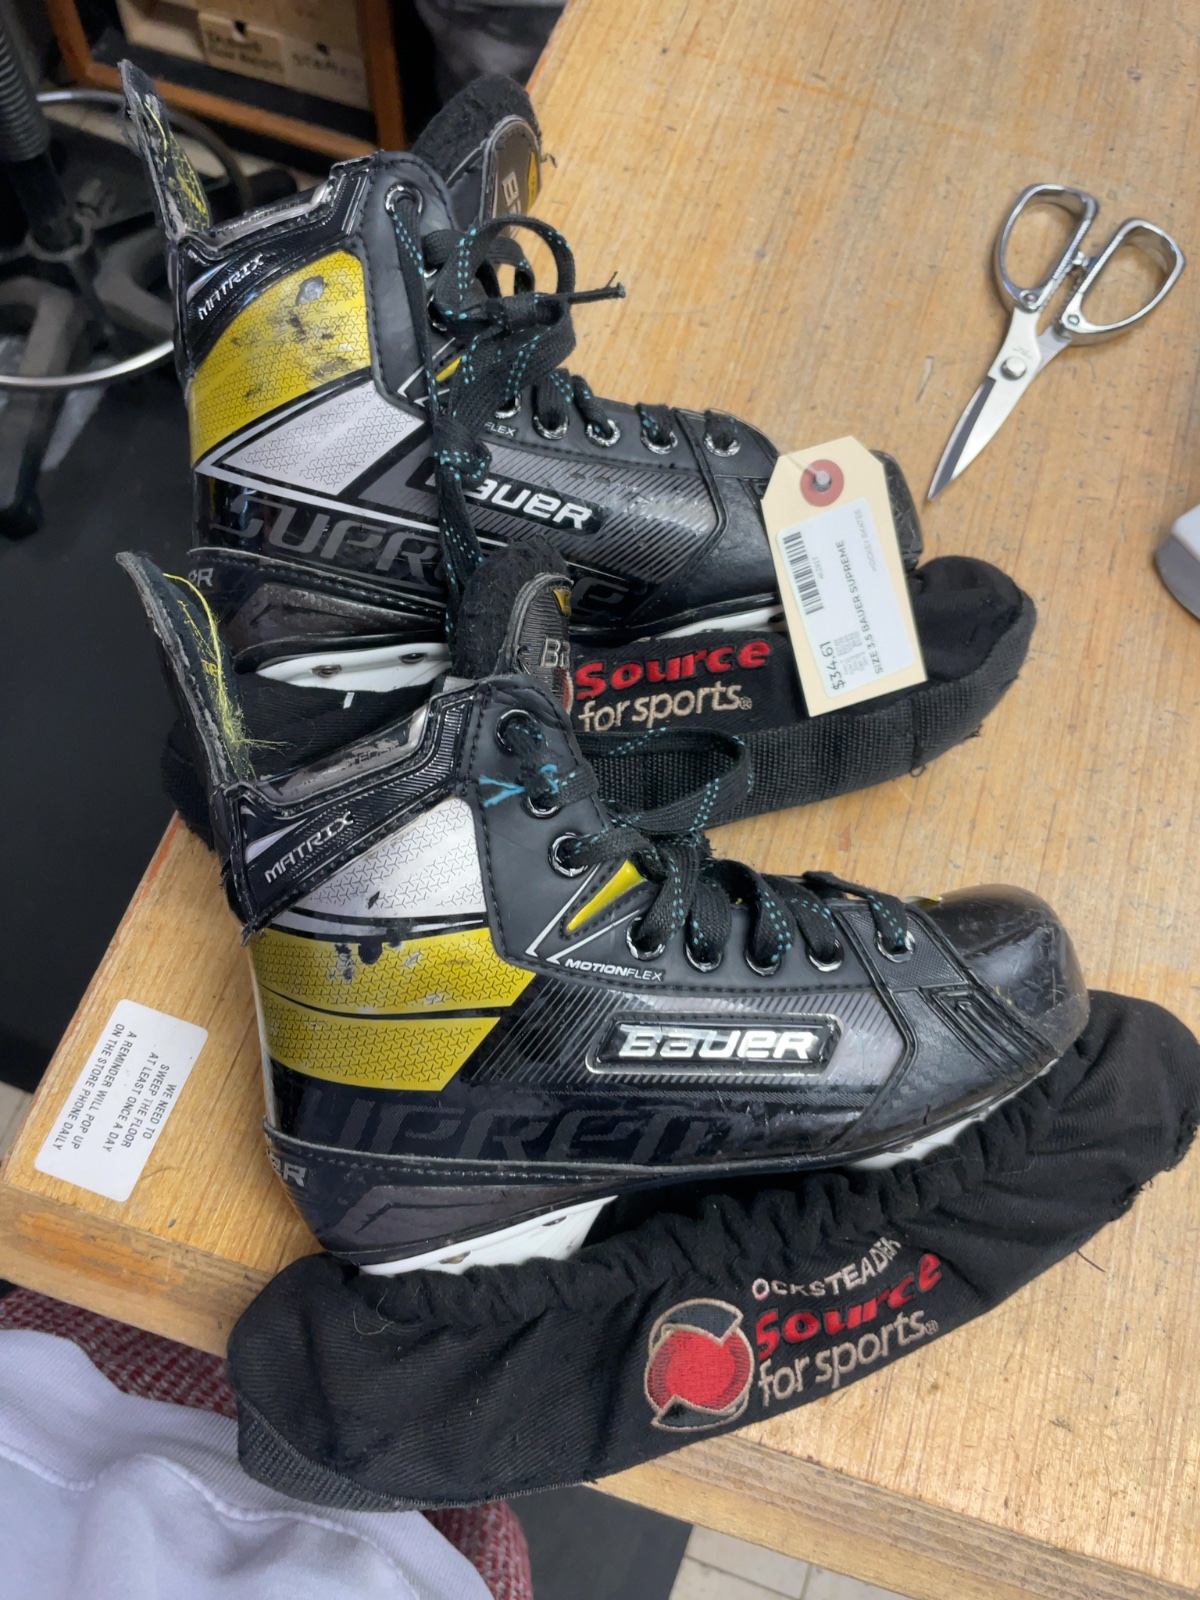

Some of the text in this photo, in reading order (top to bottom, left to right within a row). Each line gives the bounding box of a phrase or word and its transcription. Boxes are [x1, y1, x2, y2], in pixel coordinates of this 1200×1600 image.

[197, 252, 265, 321] MATRIX
[854, 509, 868, 539] SKATES
[835, 540, 883, 674] SIZE 3.5 BAUER SUPREME
[576, 640, 771, 699] Source
[819, 641, 845, 690] $34.61
[578, 700, 630, 732] for
[264, 811, 354, 883] MATRIX
[565, 958, 662, 982] MOTIONFLEX
[105, 1039, 133, 1088] REMINDER
[132, 1066, 150, 1096] LEAST
[147, 1052, 159, 1066] AT
[53, 1023, 125, 1151] ON THE STORE PHONE DAILY
[88, 1090, 108, 1111] WILL
[118, 1096, 137, 1122] ONCE
[121, 1064, 170, 1148] SWEEP THE FLOOR
[142, 1083, 177, 1140] WE NEED TO
[71, 1135, 84, 1150] UP
[79, 1113, 95, 1134] POP
[103, 1131, 119, 1152] DAY
[756, 1253, 941, 1361] Source
[759, 1356, 810, 1407] for
